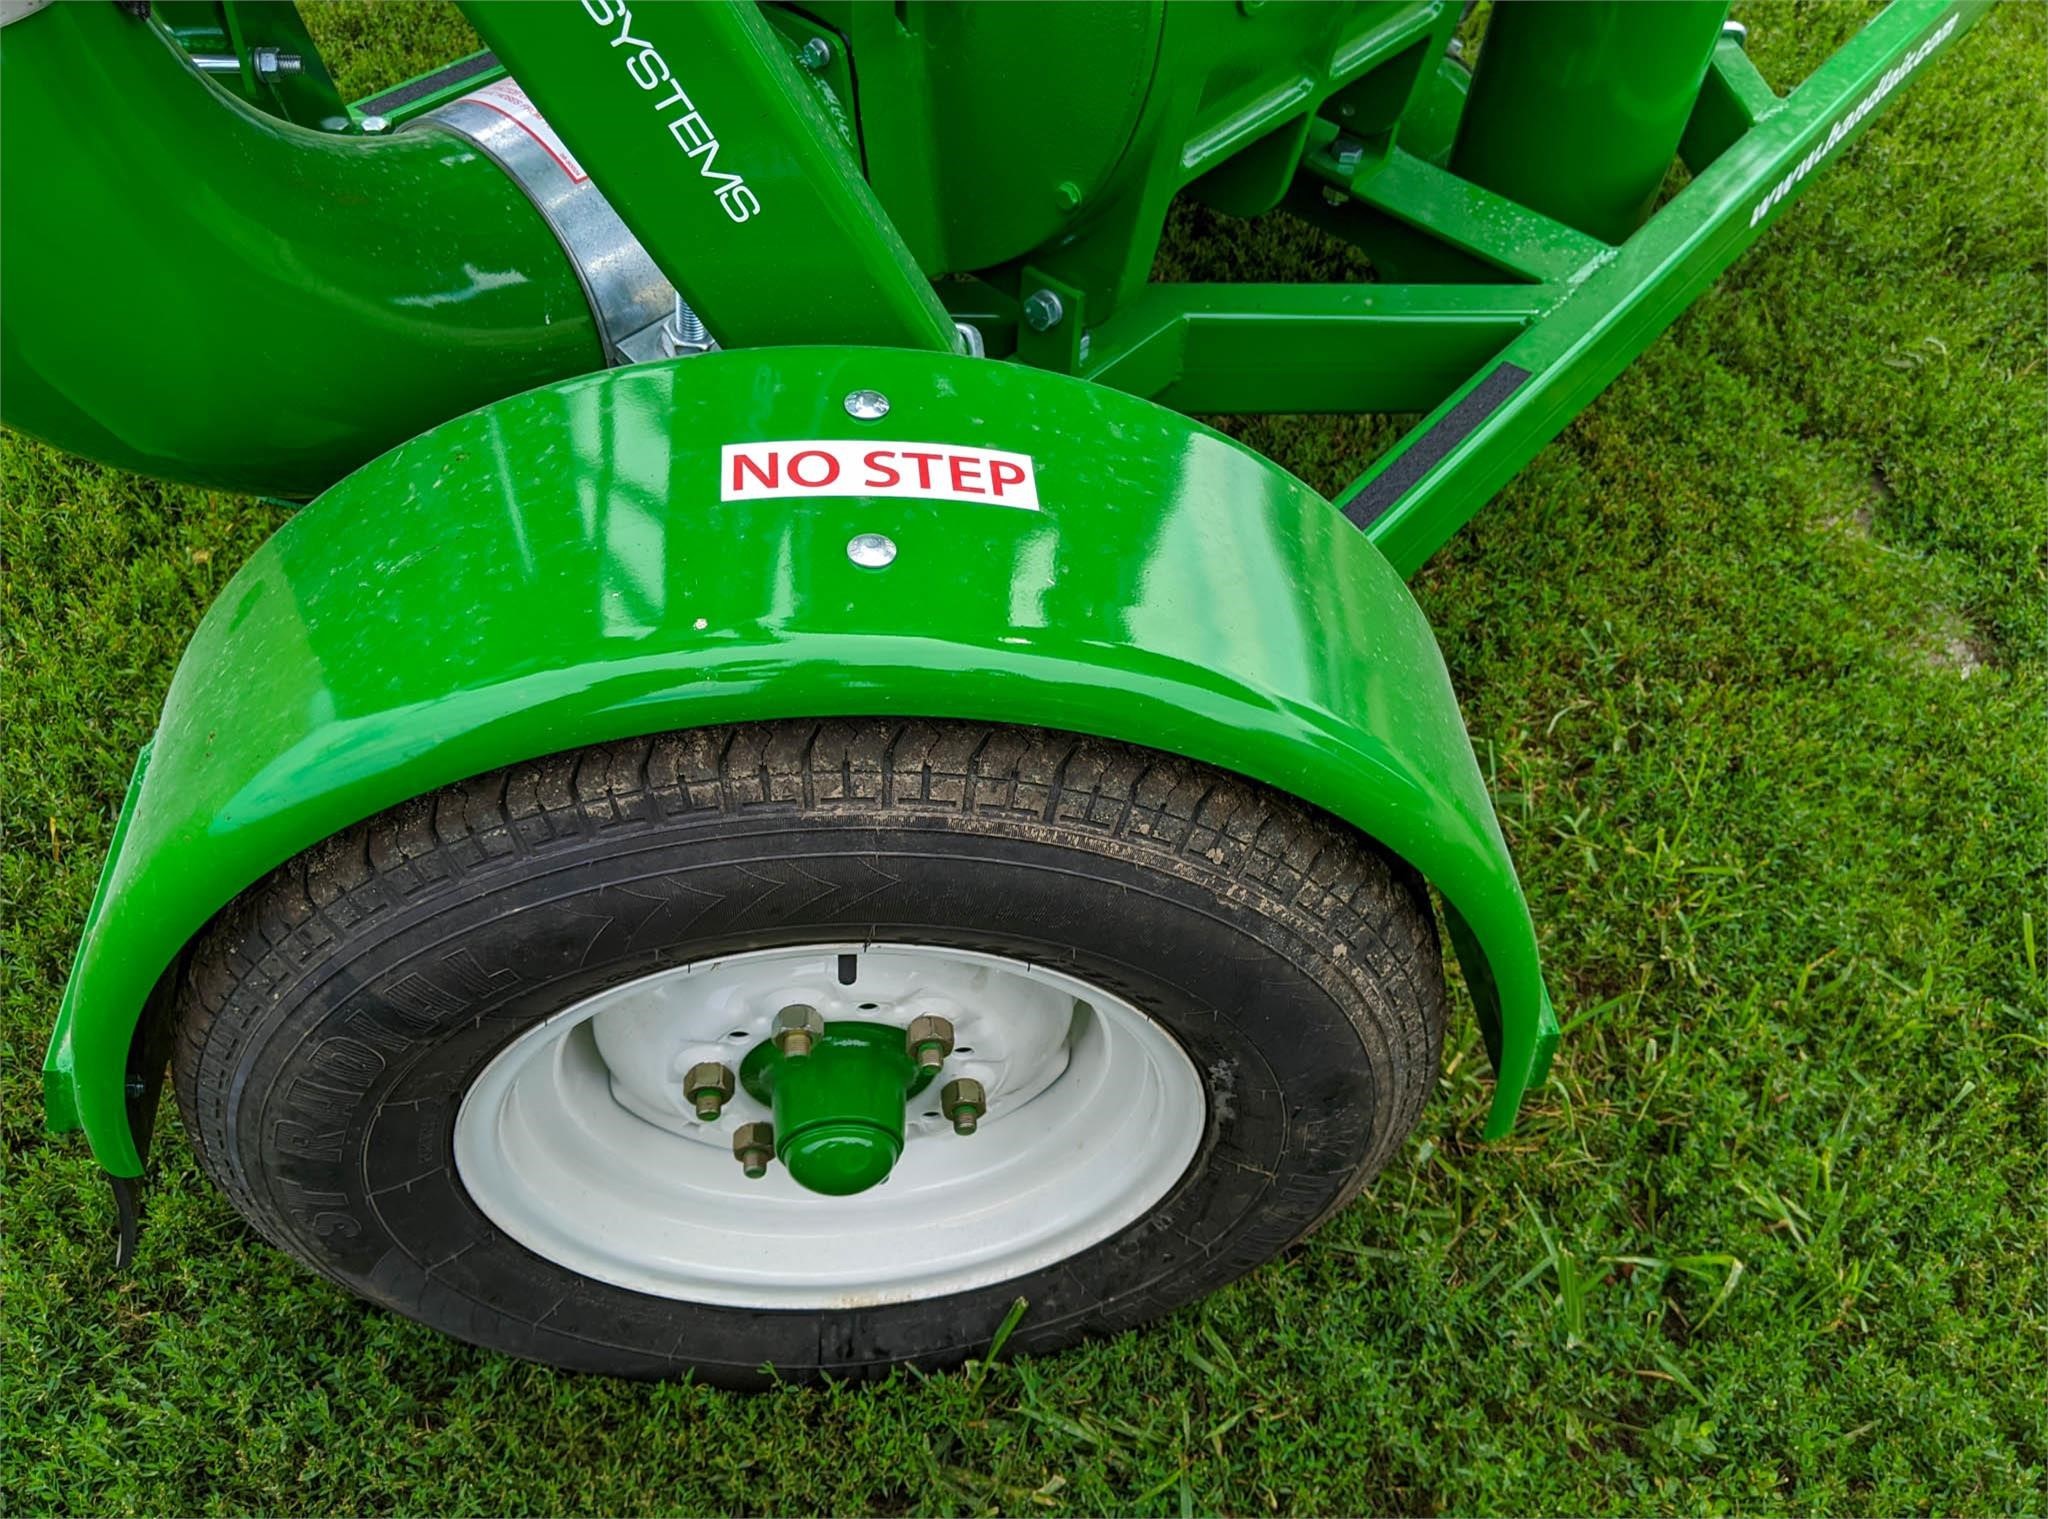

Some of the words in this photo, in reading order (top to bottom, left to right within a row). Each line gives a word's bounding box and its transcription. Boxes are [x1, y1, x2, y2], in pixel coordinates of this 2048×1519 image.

[580, 0, 761, 223] SYSTEMS
[733, 450, 841, 491] NO
[863, 450, 1026, 496] STEP
[272, 947, 523, 1164] RADIAL
